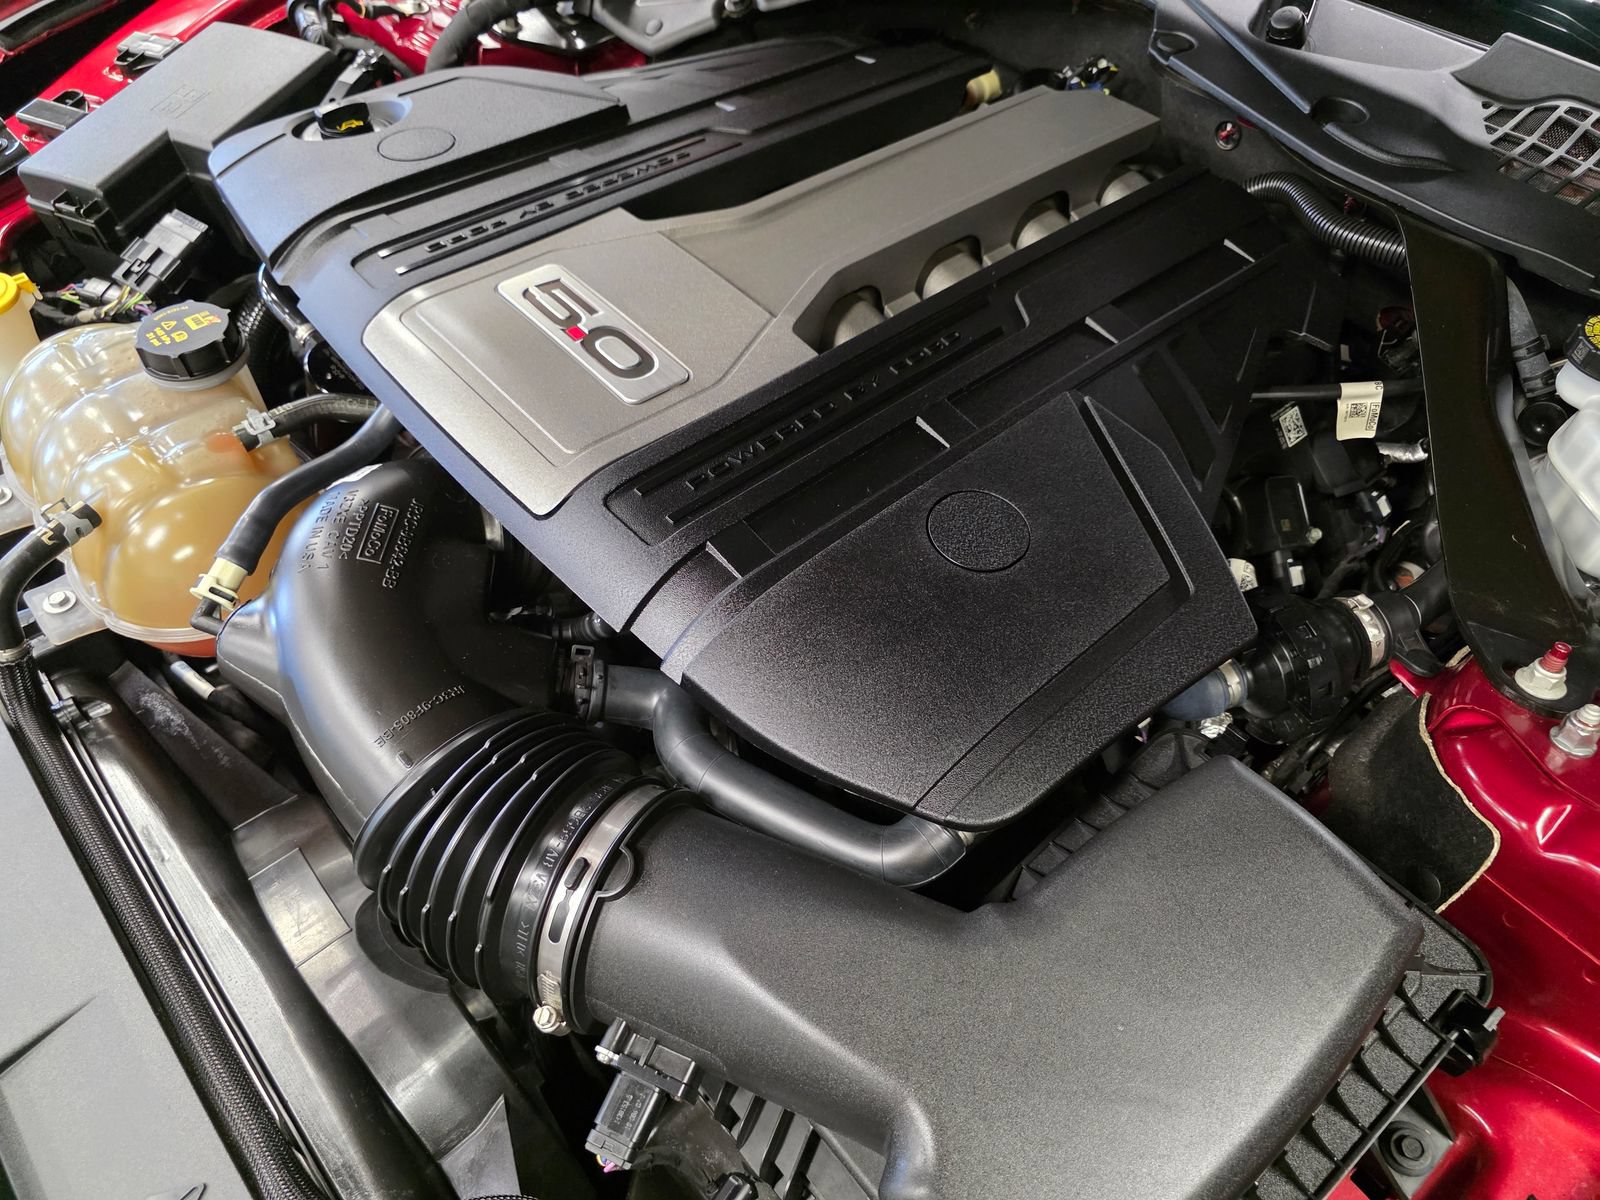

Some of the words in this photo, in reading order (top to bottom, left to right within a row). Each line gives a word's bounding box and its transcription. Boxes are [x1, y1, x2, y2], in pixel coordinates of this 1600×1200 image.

[521, 278, 660, 380] 5.0
[684, 401, 837, 491] POWERED
[1367, 403, 1380, 430] FoMoCo
[363, 506, 395, 557] FoMoCo
